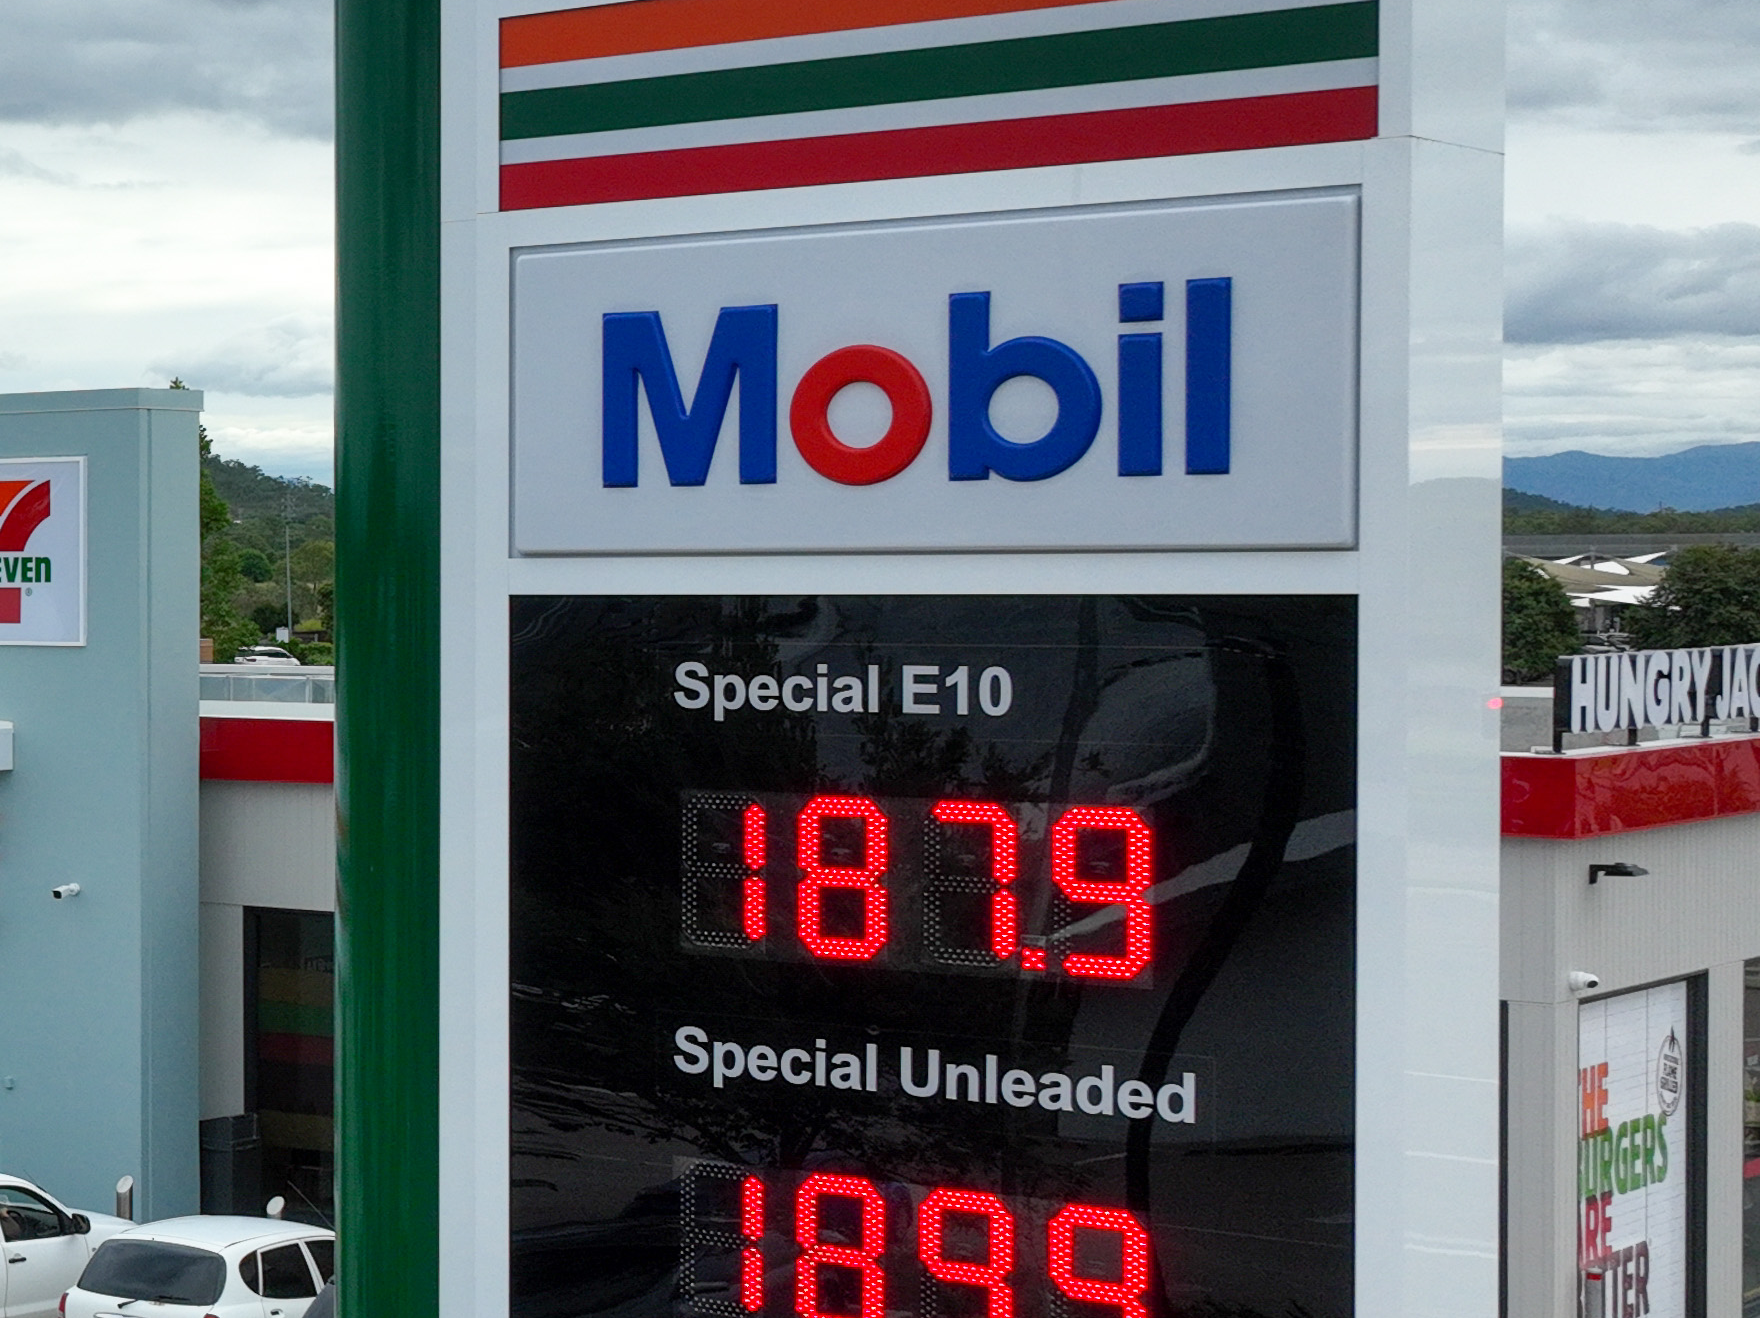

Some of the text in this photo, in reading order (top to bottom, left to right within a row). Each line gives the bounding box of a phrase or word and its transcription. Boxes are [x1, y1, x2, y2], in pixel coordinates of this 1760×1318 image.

[602, 276, 1233, 488] Mobil
[673, 661, 1013, 721] Special E10
[1571, 648, 1712, 734] HUNGRY
[744, 795, 1152, 979] 187.9
[673, 1026, 1197, 1124] Special Unleaded
[1578, 1062, 1608, 1141] HE
[1579, 1113, 1668, 1202] URGERS
[1579, 1190, 1612, 1271] RE
